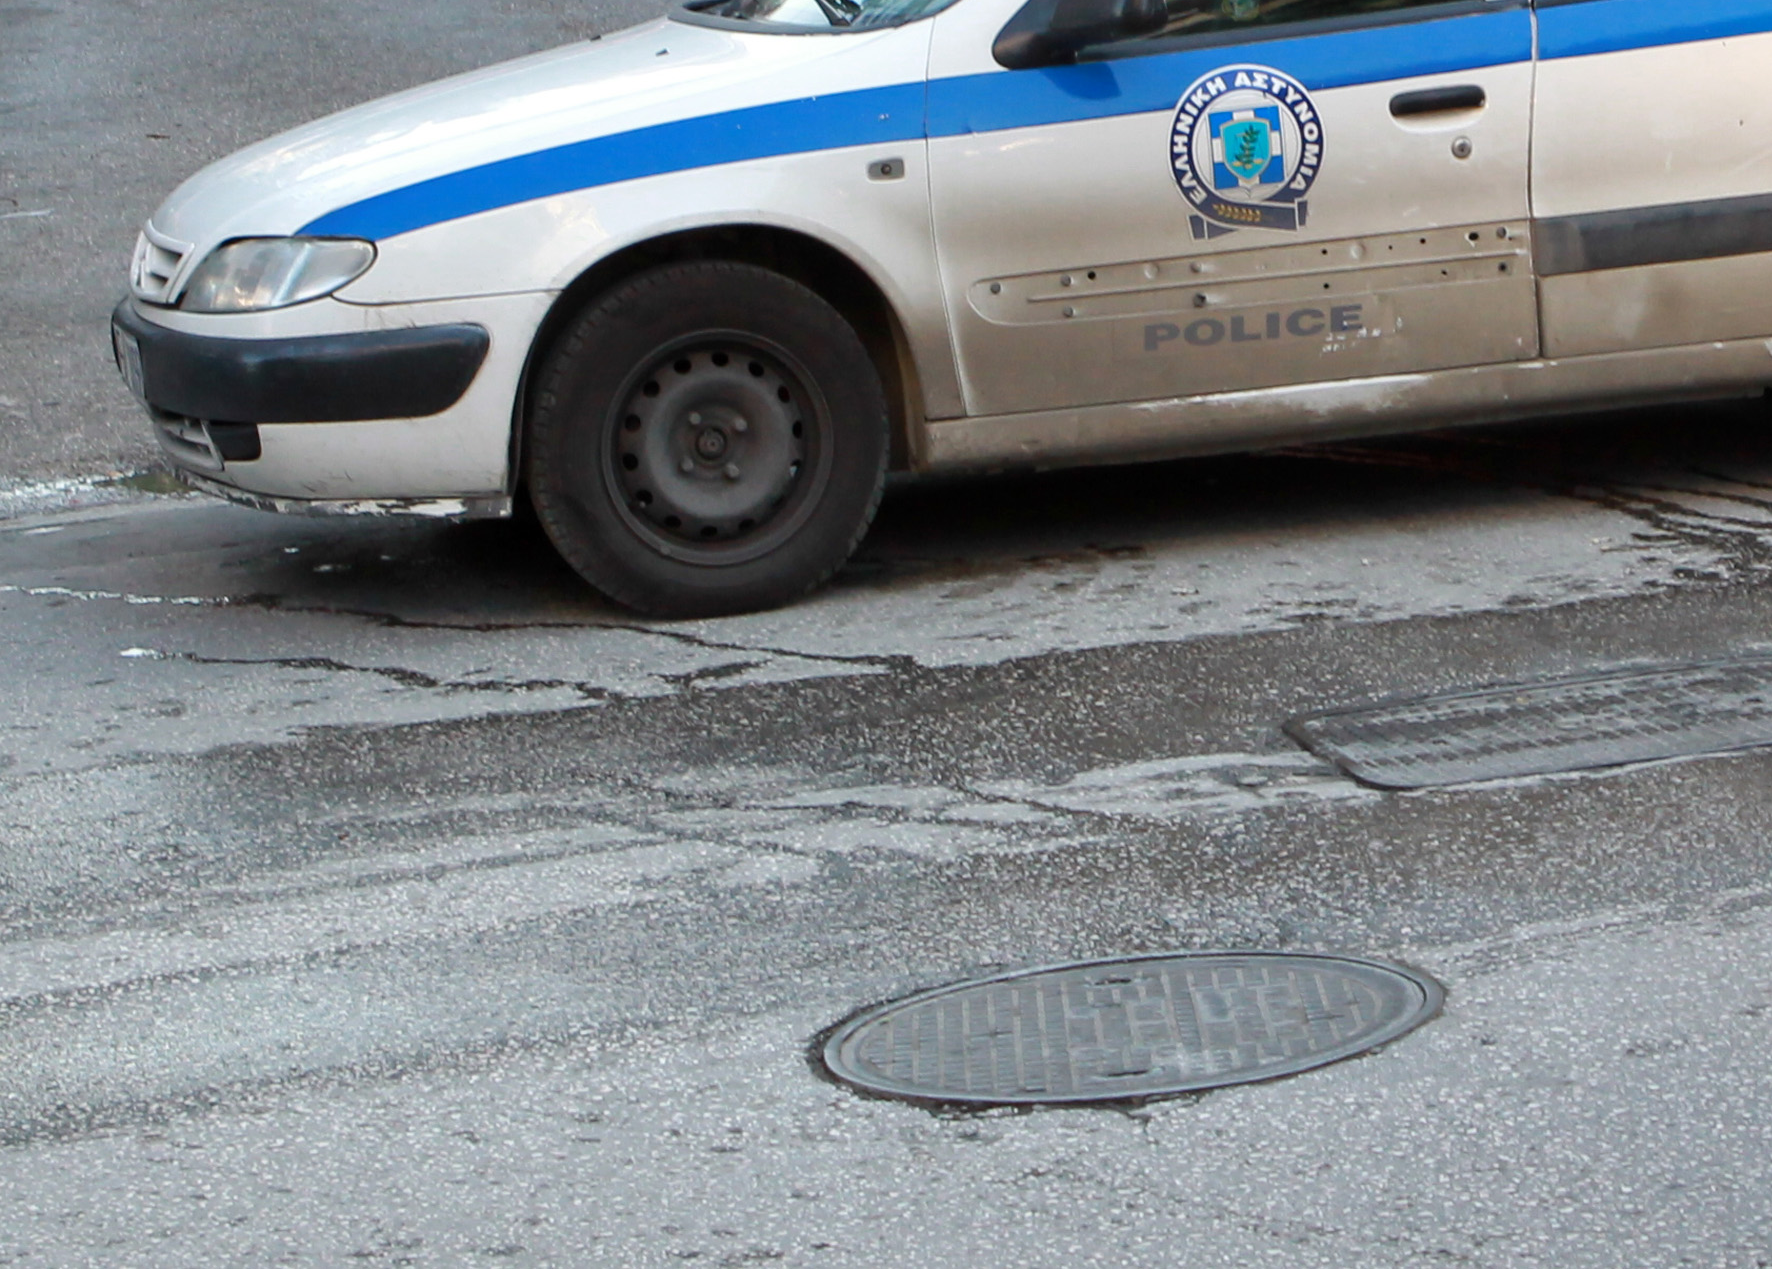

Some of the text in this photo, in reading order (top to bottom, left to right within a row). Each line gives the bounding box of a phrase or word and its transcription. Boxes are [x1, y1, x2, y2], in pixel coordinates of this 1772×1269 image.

[1173, 71, 1320, 206] ΕΛΛΗΝΙΚΗ ΑΣΤΥΝΟΜΙΑ
[1142, 303, 1365, 352] POLICE
